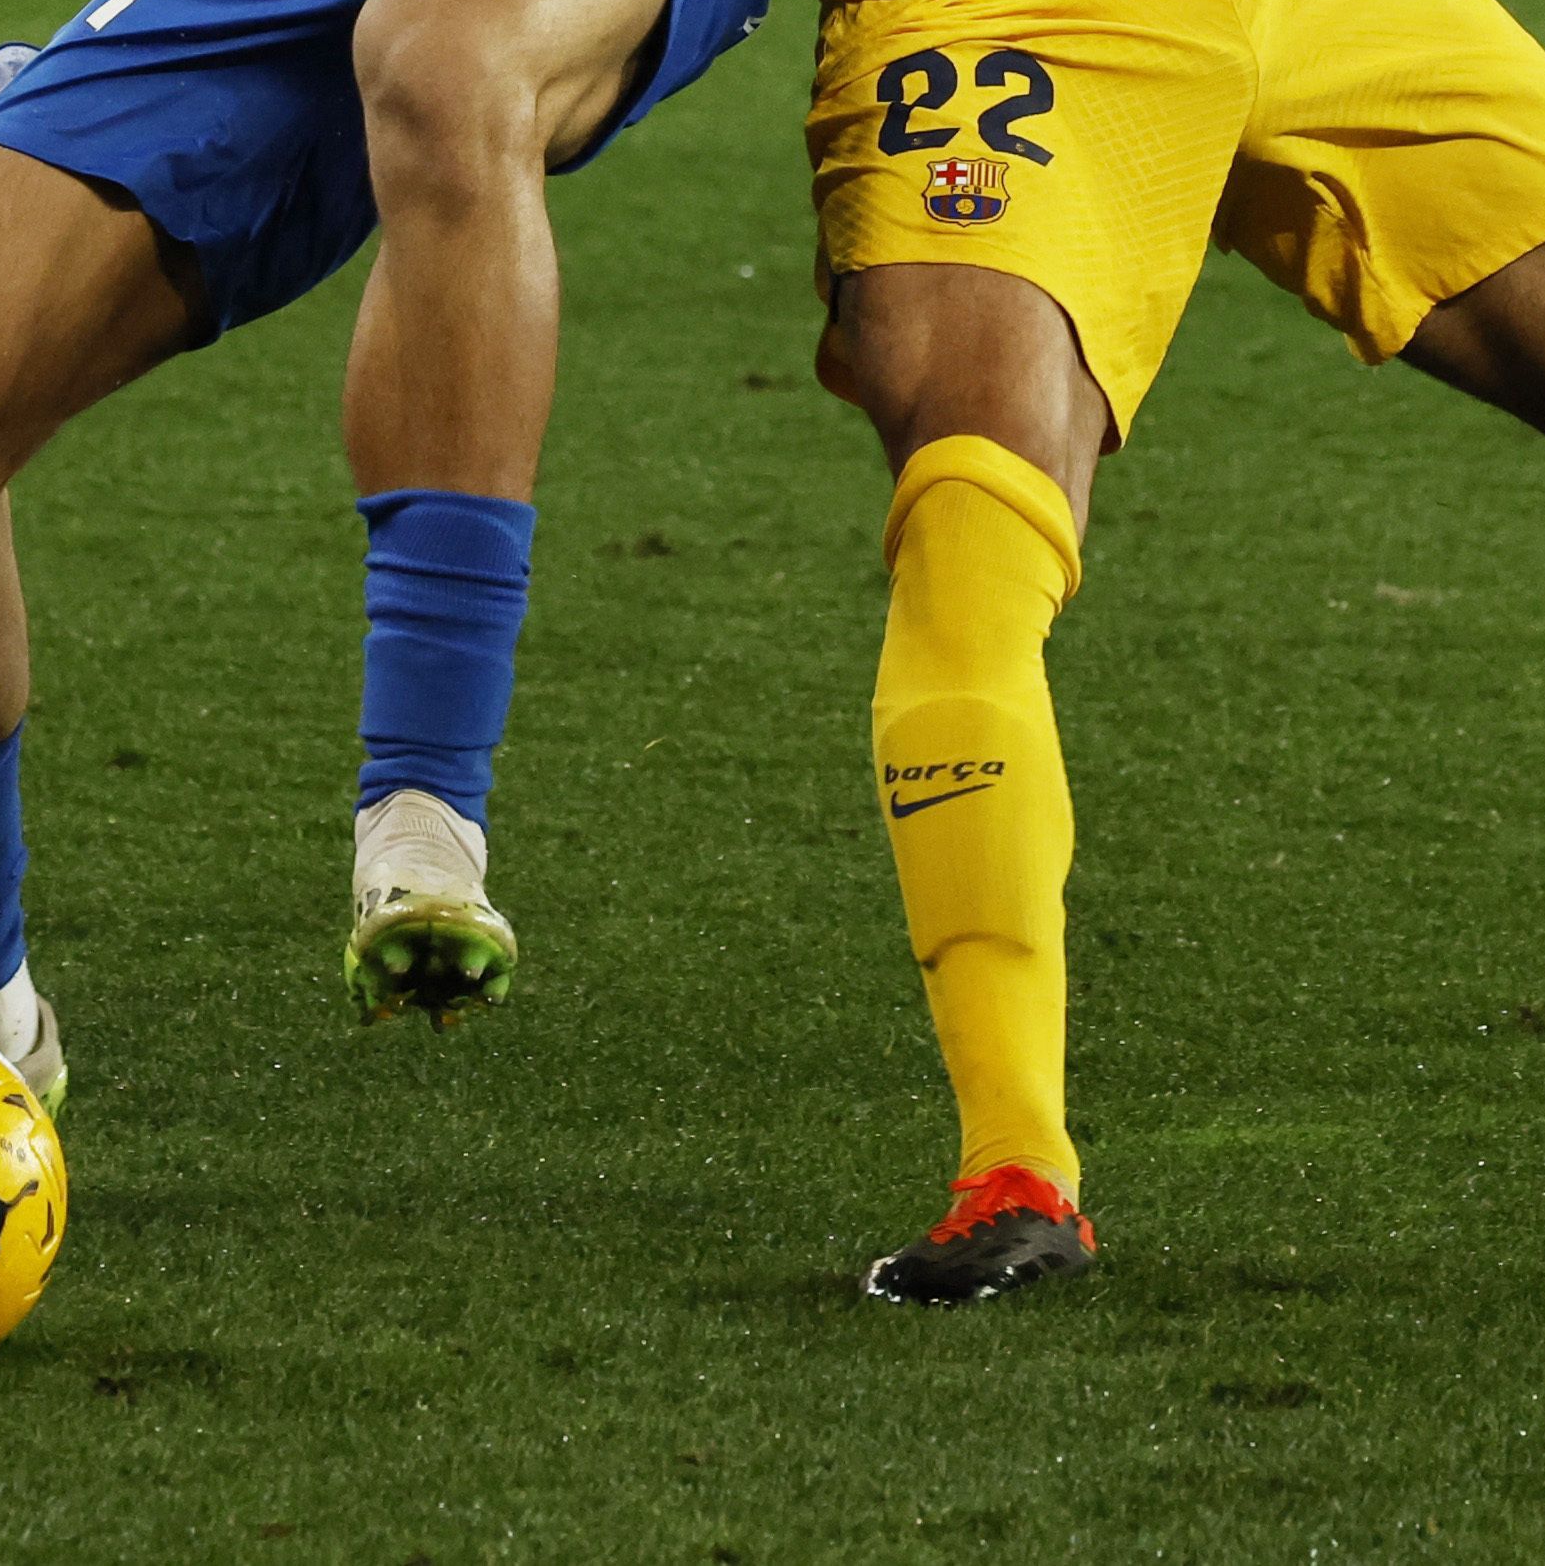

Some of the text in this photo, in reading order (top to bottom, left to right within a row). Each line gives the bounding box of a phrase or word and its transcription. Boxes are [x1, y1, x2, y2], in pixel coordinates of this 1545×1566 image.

[876, 49, 1055, 167] 22
[949, 184, 983, 196] FCB
[885, 760, 1006, 785] barça
